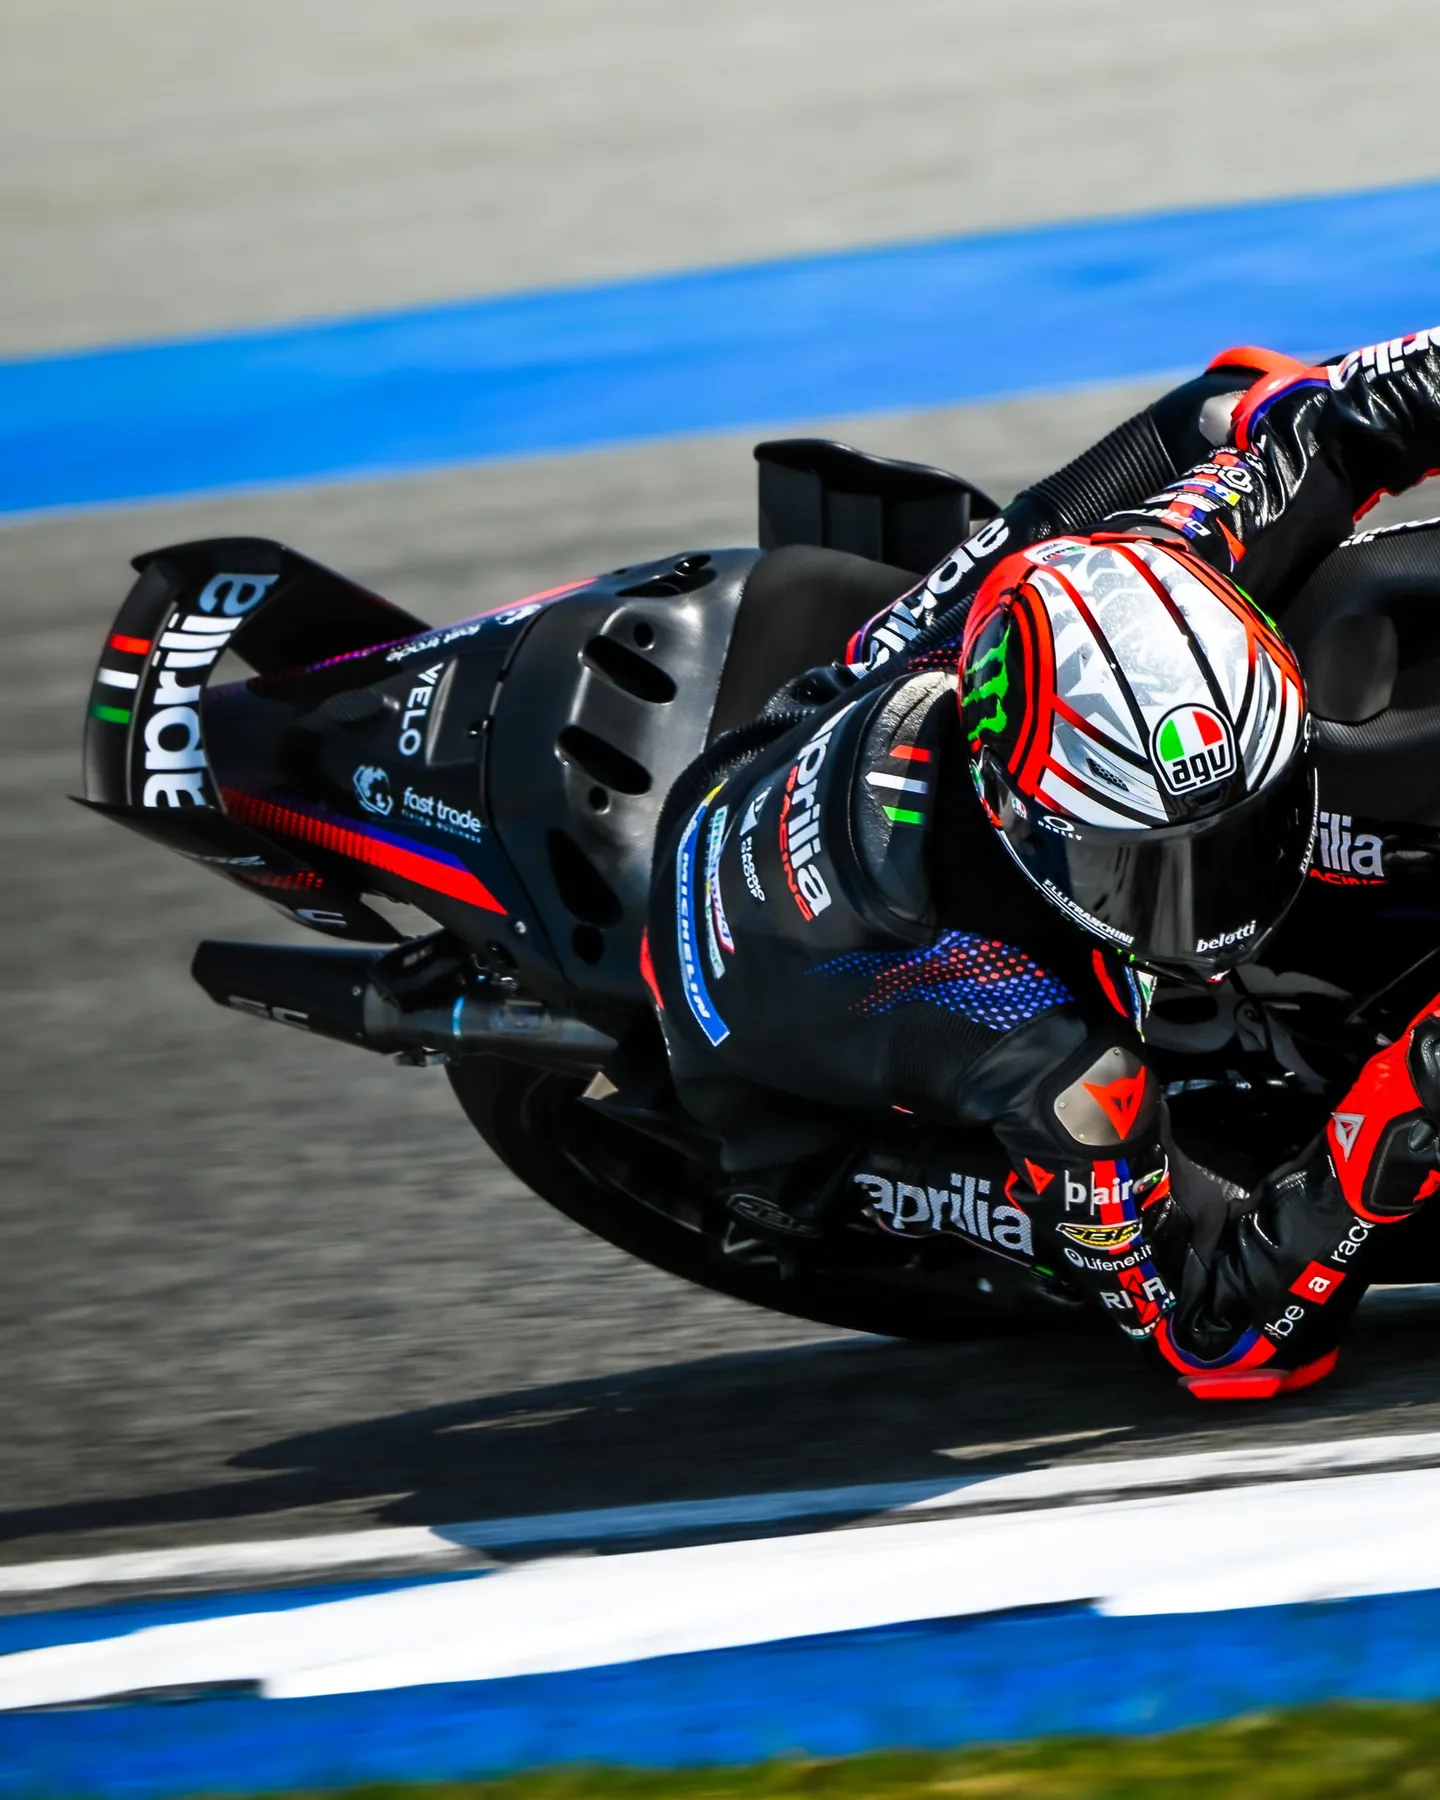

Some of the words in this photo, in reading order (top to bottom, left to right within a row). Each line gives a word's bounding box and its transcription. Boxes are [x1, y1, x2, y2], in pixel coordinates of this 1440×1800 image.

[143, 573, 281, 808] aprilia
[399, 662, 444, 756] VELO
[1172, 744, 1226, 785] agv
[403, 786, 434, 816] fast
[437, 799, 481, 832] trade
[1310, 811, 1385, 877] ilia
[680, 852, 711, 1019] MICHELIN
[1195, 920, 1257, 953] belotti
[853, 1172, 1035, 1257] aprilia
[1084, 1244, 1153, 1272] Lifenet.it
[1307, 1276, 1332, 1293] a
